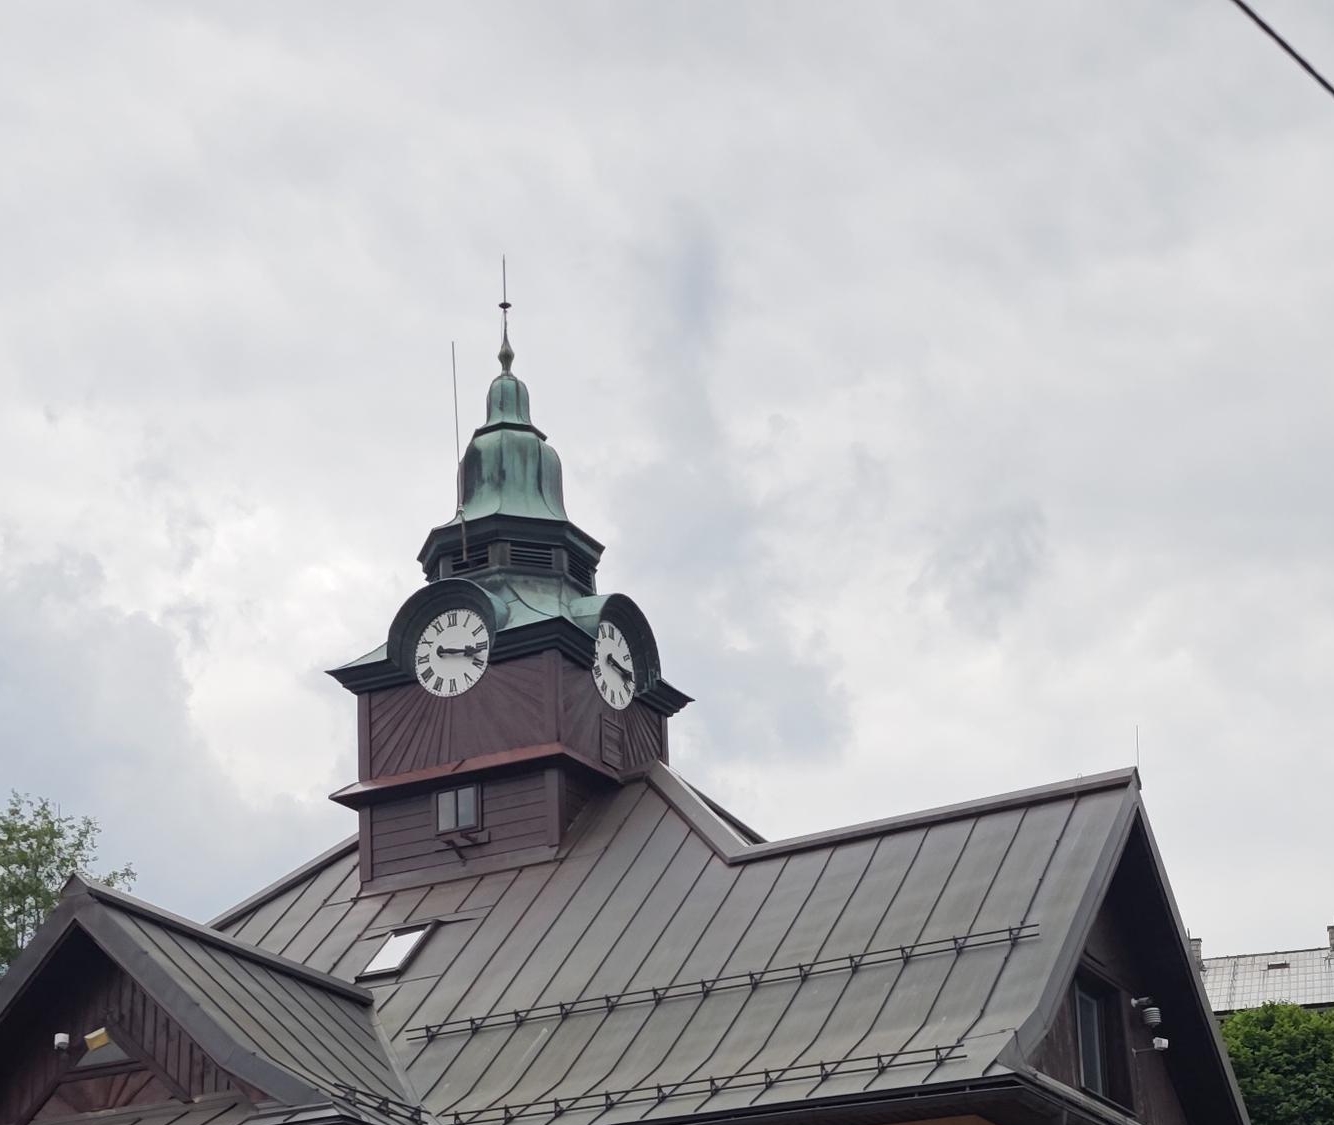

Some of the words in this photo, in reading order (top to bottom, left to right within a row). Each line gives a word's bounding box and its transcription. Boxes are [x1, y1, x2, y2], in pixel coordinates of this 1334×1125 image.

[447, 613, 457, 628] XII
[463, 614, 471, 628] I
[432, 621, 444, 636] XI
[472, 624, 484, 637] II
[421, 638, 433, 648] X
[418, 653, 430, 665] IX
[449, 678, 457, 692] VI
